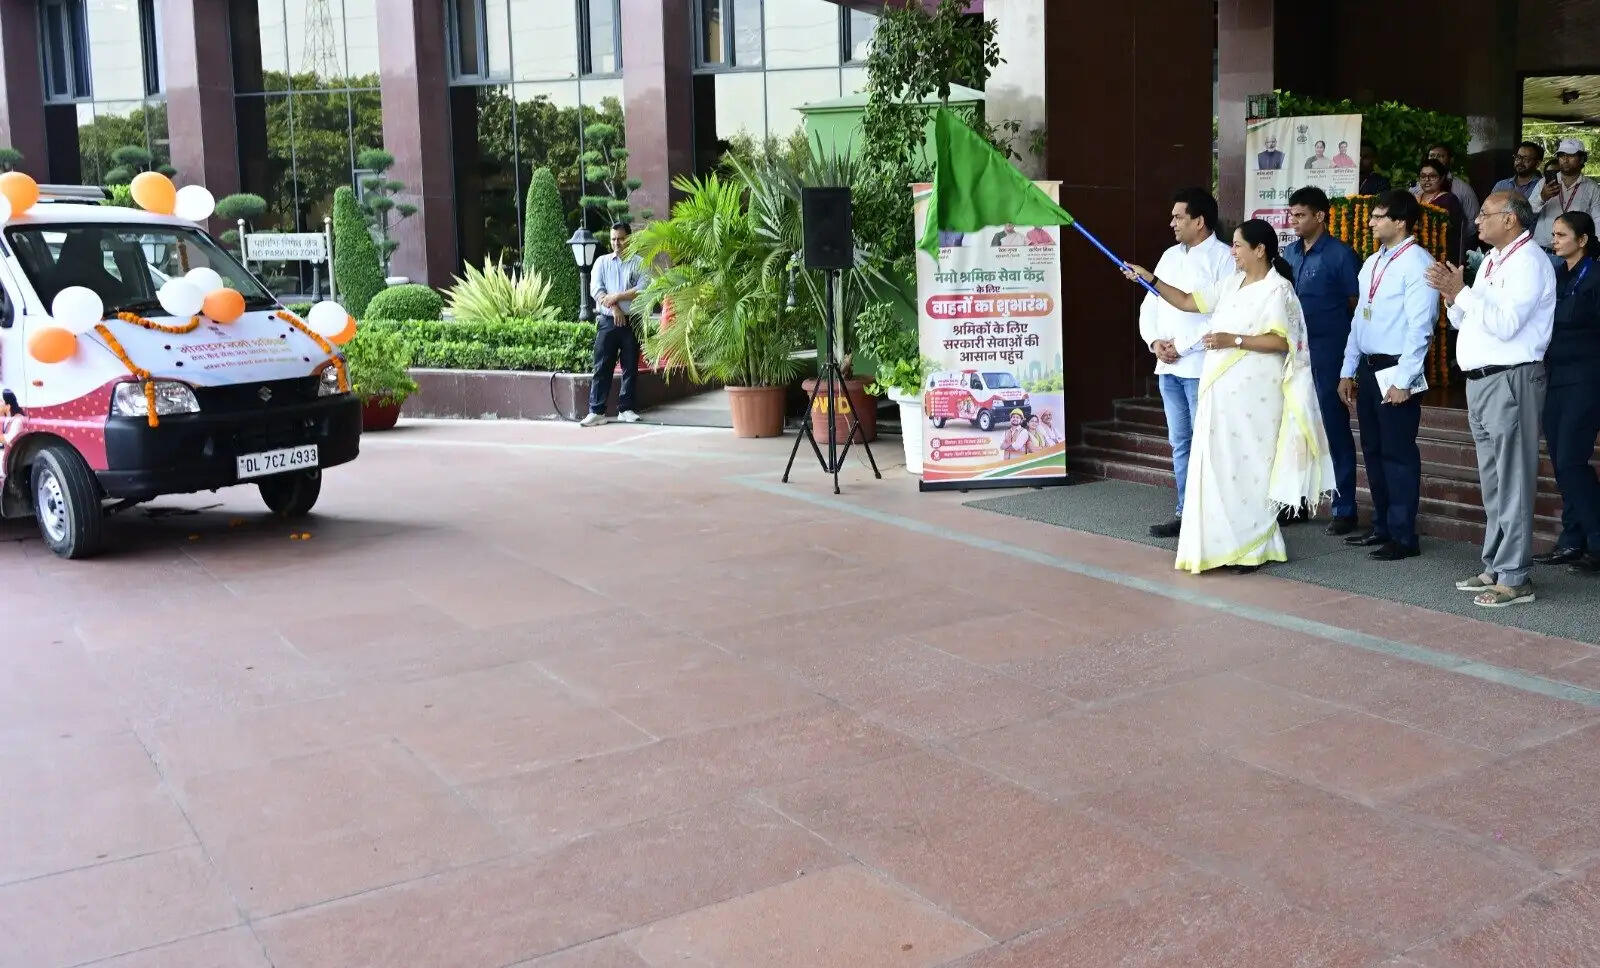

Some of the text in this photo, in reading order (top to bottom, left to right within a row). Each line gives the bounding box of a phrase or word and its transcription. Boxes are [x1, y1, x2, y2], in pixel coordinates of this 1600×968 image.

[1258, 188, 1276, 200] नमो
[252, 248, 321, 258] NO PARKING ZONE
[934, 266, 1045, 283] नमो श्रमिक सेवा केंद्र
[976, 284, 1001, 293] के लिए
[932, 294, 1048, 317] वाहनों का शुभारंभ
[953, 320, 1029, 336] श्रमिकों के लिए
[943, 333, 1040, 350] सरकारी सेवाओं की
[960, 348, 1024, 364] आसान पहुंच
[246, 448, 317, 472] DL 7CZ 4933
